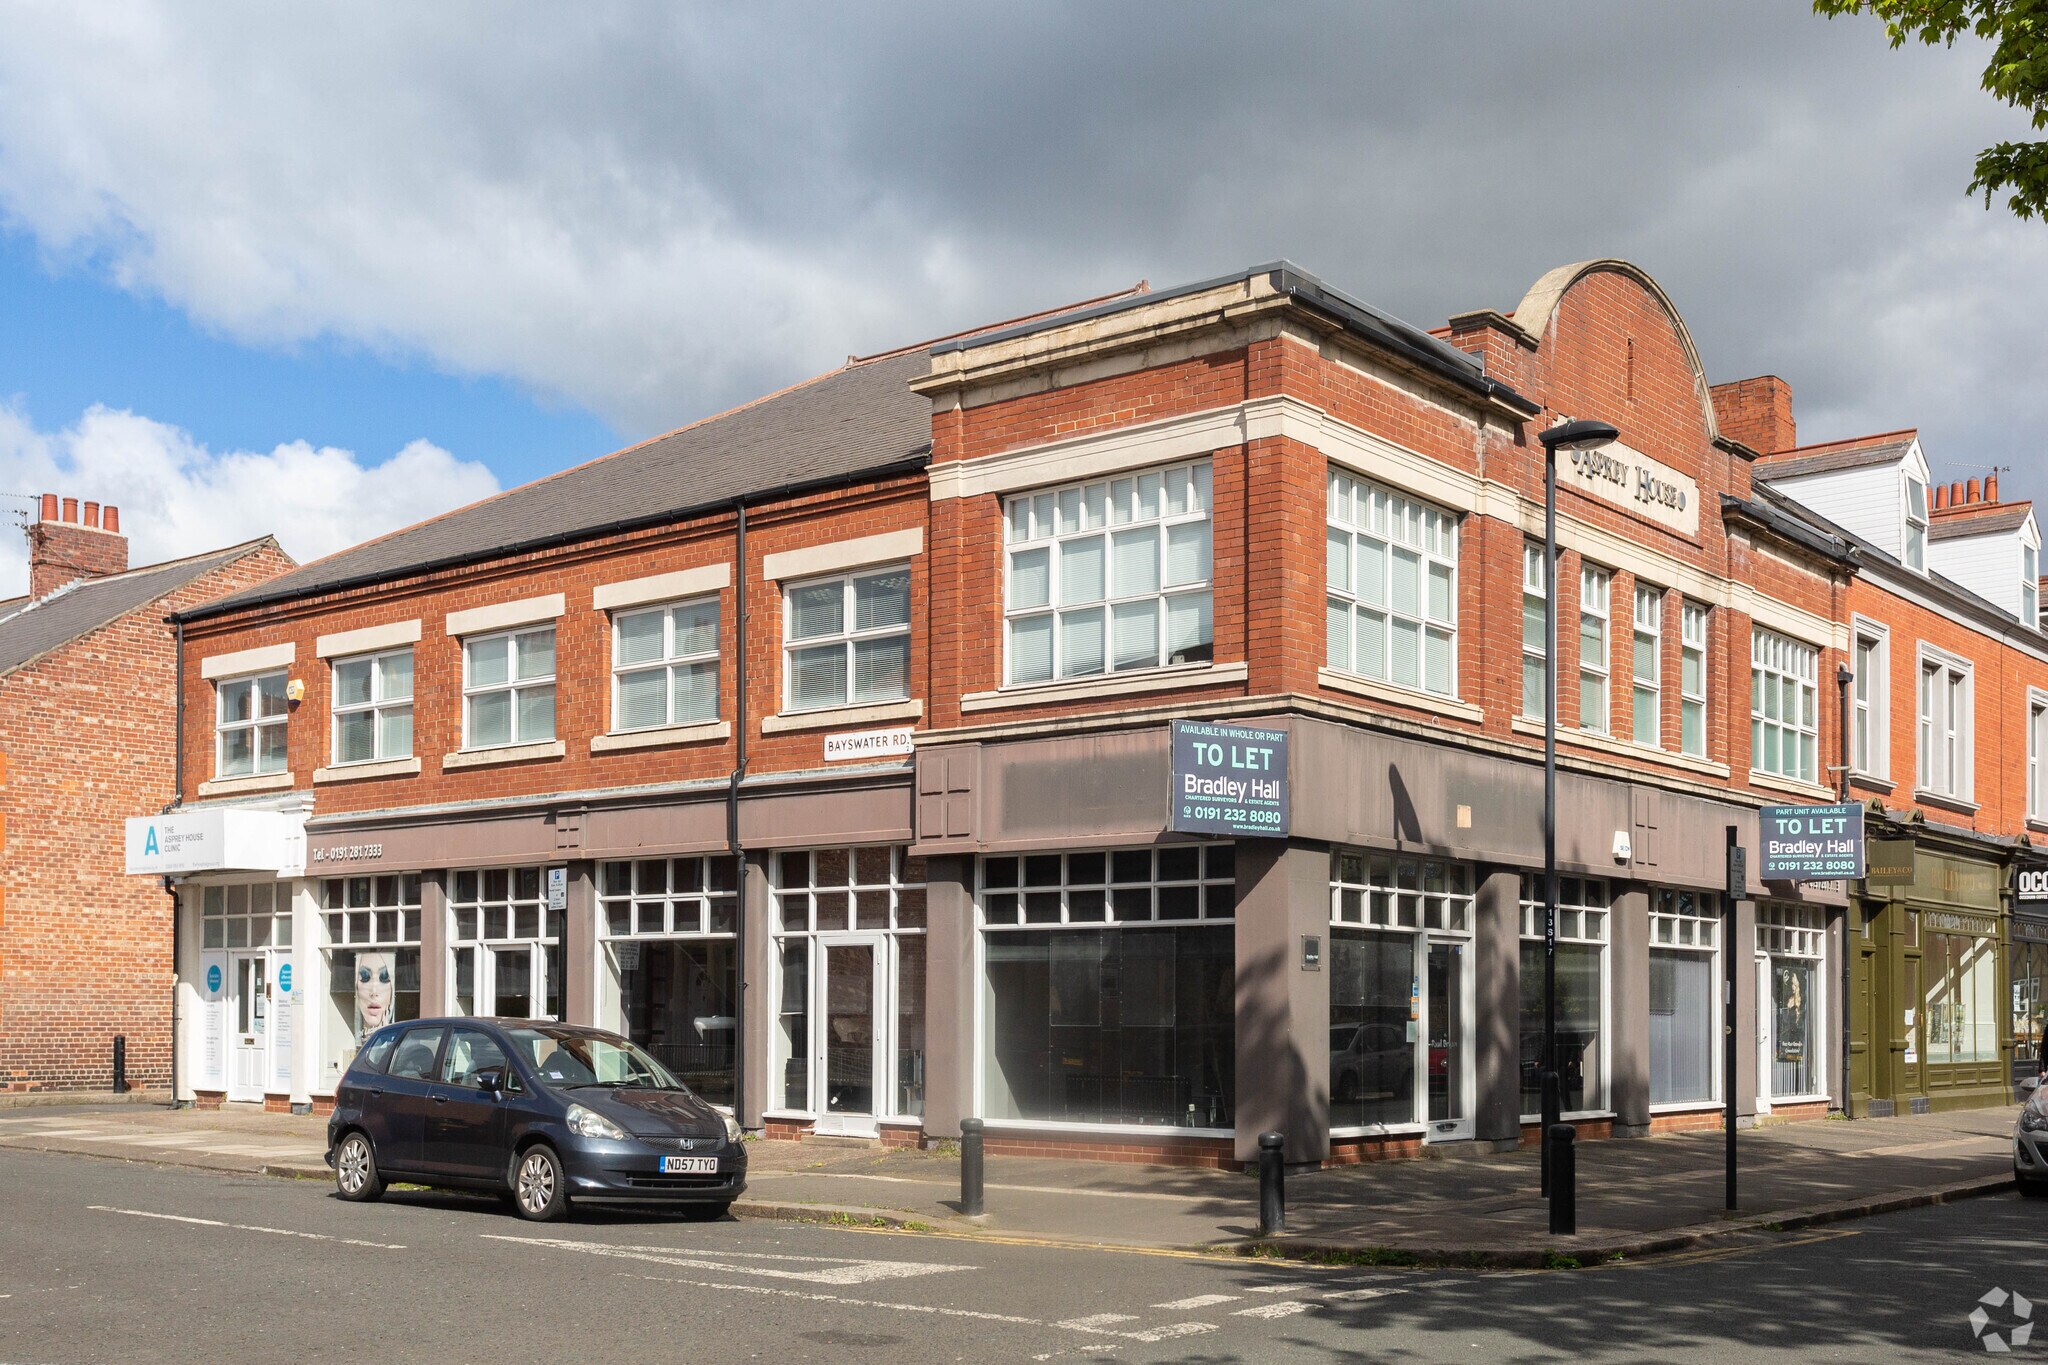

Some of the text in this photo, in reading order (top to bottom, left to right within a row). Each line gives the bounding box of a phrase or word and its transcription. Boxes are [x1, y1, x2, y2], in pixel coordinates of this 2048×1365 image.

[1180, 725, 1219, 736] AVAILABLE
[1220, 729, 1228, 737] IN
[1229, 730, 1254, 740] WHOLE
[1266, 734, 1283, 742] PART
[828, 735, 889, 752] BAYSWATER
[1193, 742, 1273, 771] TO LET
[1184, 773, 1280, 804] Bradley Hall
[1194, 806, 1281, 824] 0191 232 8080
[164, 826, 175, 834] THE
[1232, 823, 1281, 832] www.bradleyhall.co.uk
[1775, 818, 1847, 835] TO LET
[144, 826, 160, 856] A
[164, 832, 204, 843] ASPREY HOUSE
[164, 844, 181, 852] CLINIC
[313, 847, 325, 861] Tel
[330, 846, 348, 861] 0191
[349, 845, 363, 860] 281
[364, 843, 383, 858] 7333
[1769, 839, 1854, 858] Bradley Hall
[1778, 860, 1856, 870] 0191 232 8080
[667, 1158, 716, 1171] ND57 TYO
